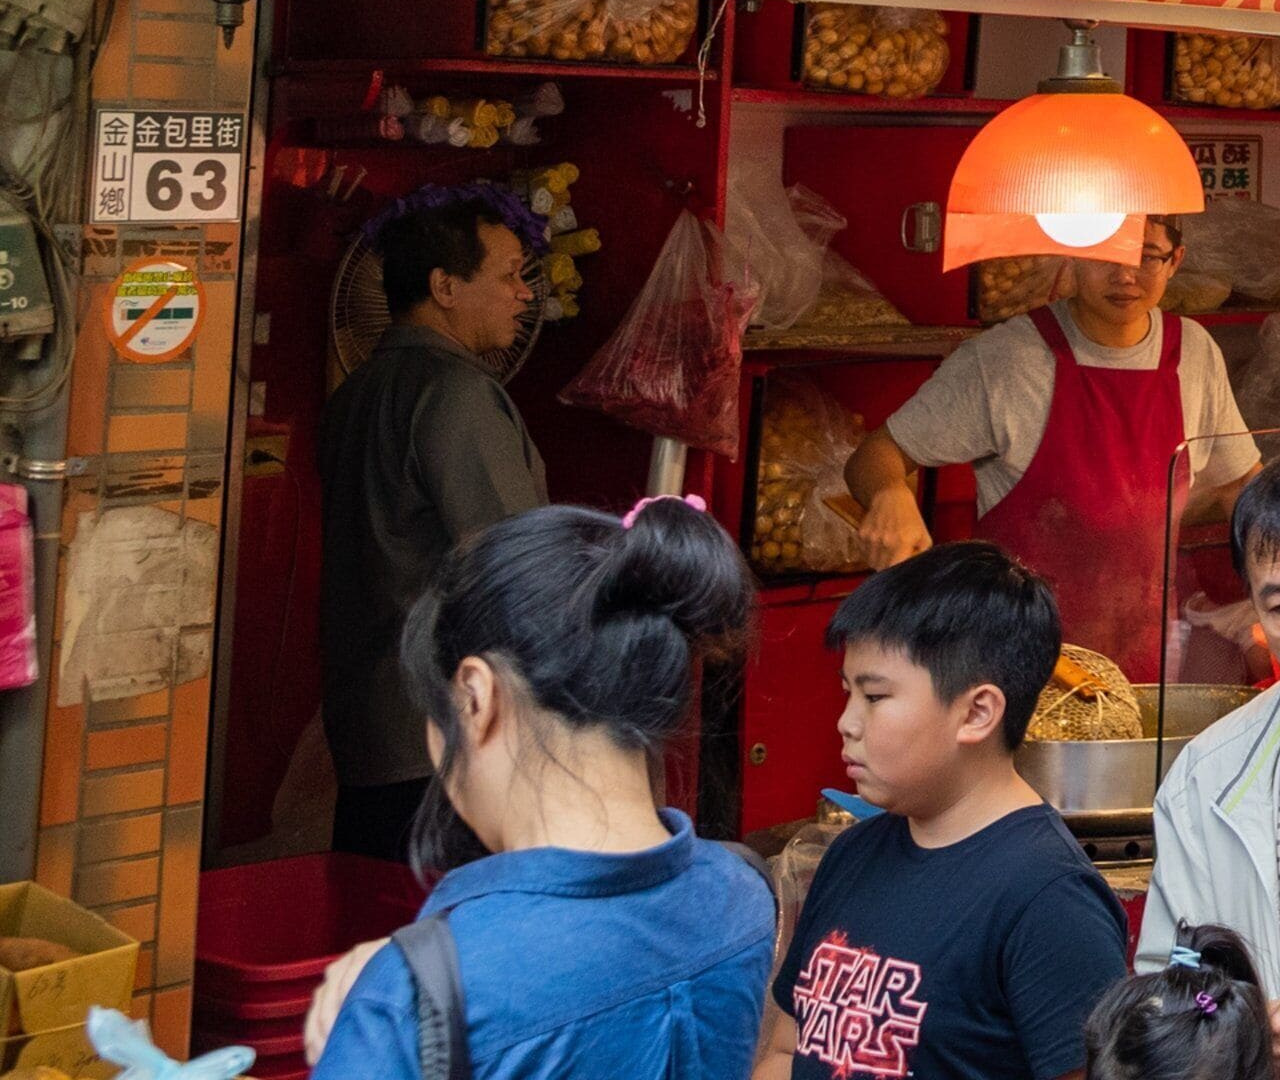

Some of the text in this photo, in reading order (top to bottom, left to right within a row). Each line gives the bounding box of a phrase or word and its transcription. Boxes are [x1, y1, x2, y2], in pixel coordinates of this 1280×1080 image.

[98, 116, 130, 216] 金山鄉
[135, 115, 242, 147] 金包里街
[146, 159, 227, 211] 63
[794, 942, 928, 1023] STAR
[794, 992, 920, 1075] WARS
